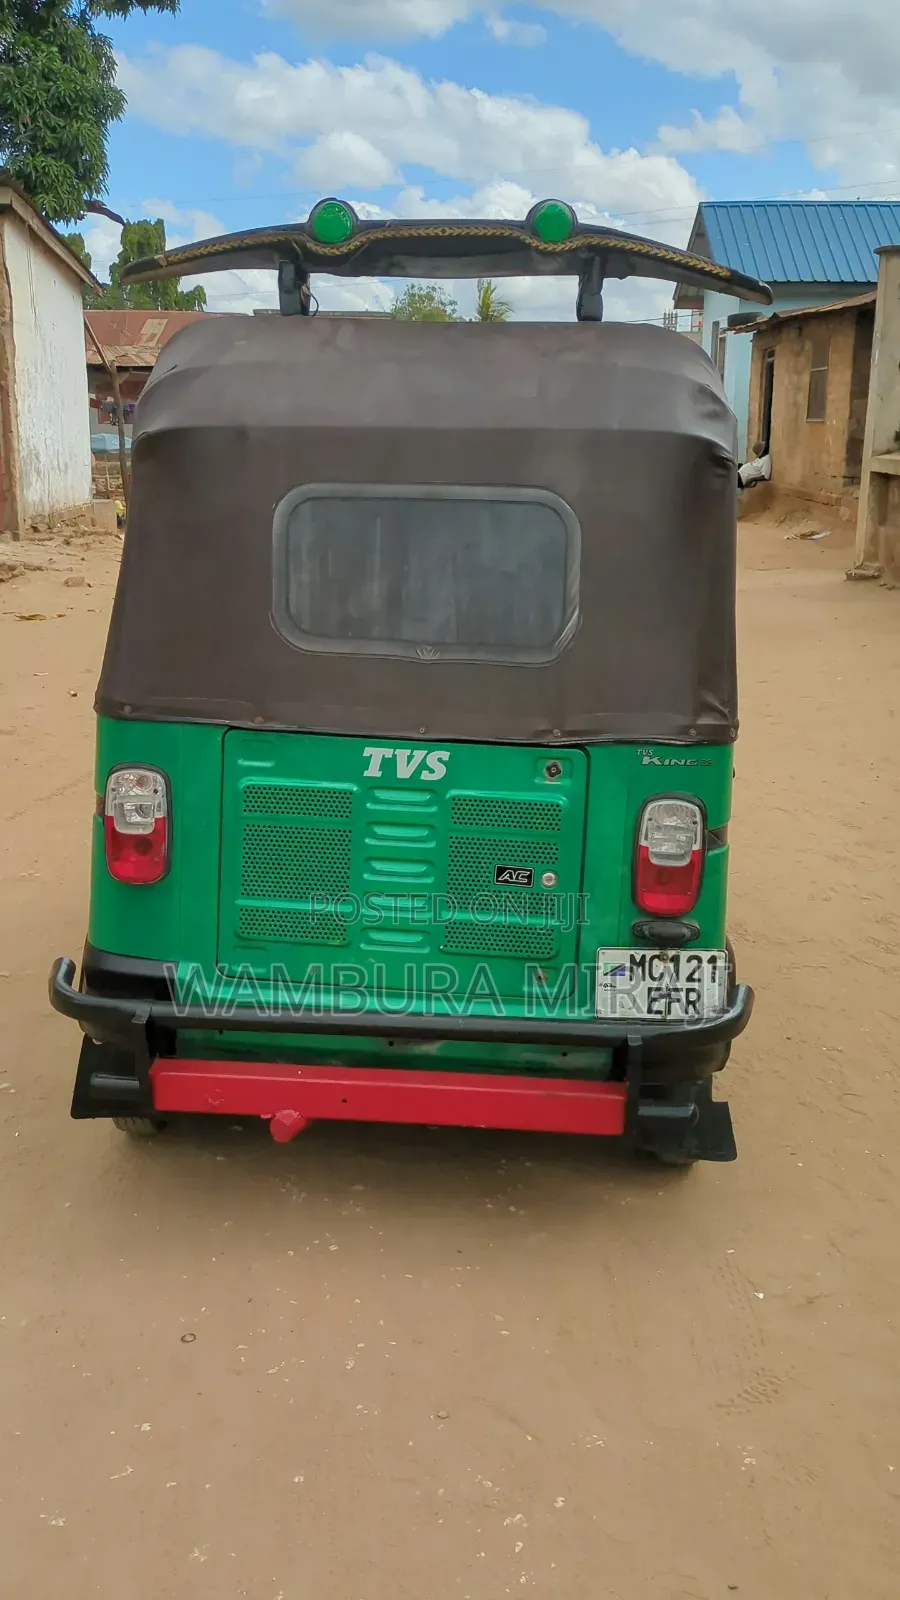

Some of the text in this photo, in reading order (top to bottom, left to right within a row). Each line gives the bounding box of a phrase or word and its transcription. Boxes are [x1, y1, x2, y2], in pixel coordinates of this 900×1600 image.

[362, 747, 450, 781] TVS
[498, 869, 531, 883] AC
[646, 986, 702, 1016] EFR
